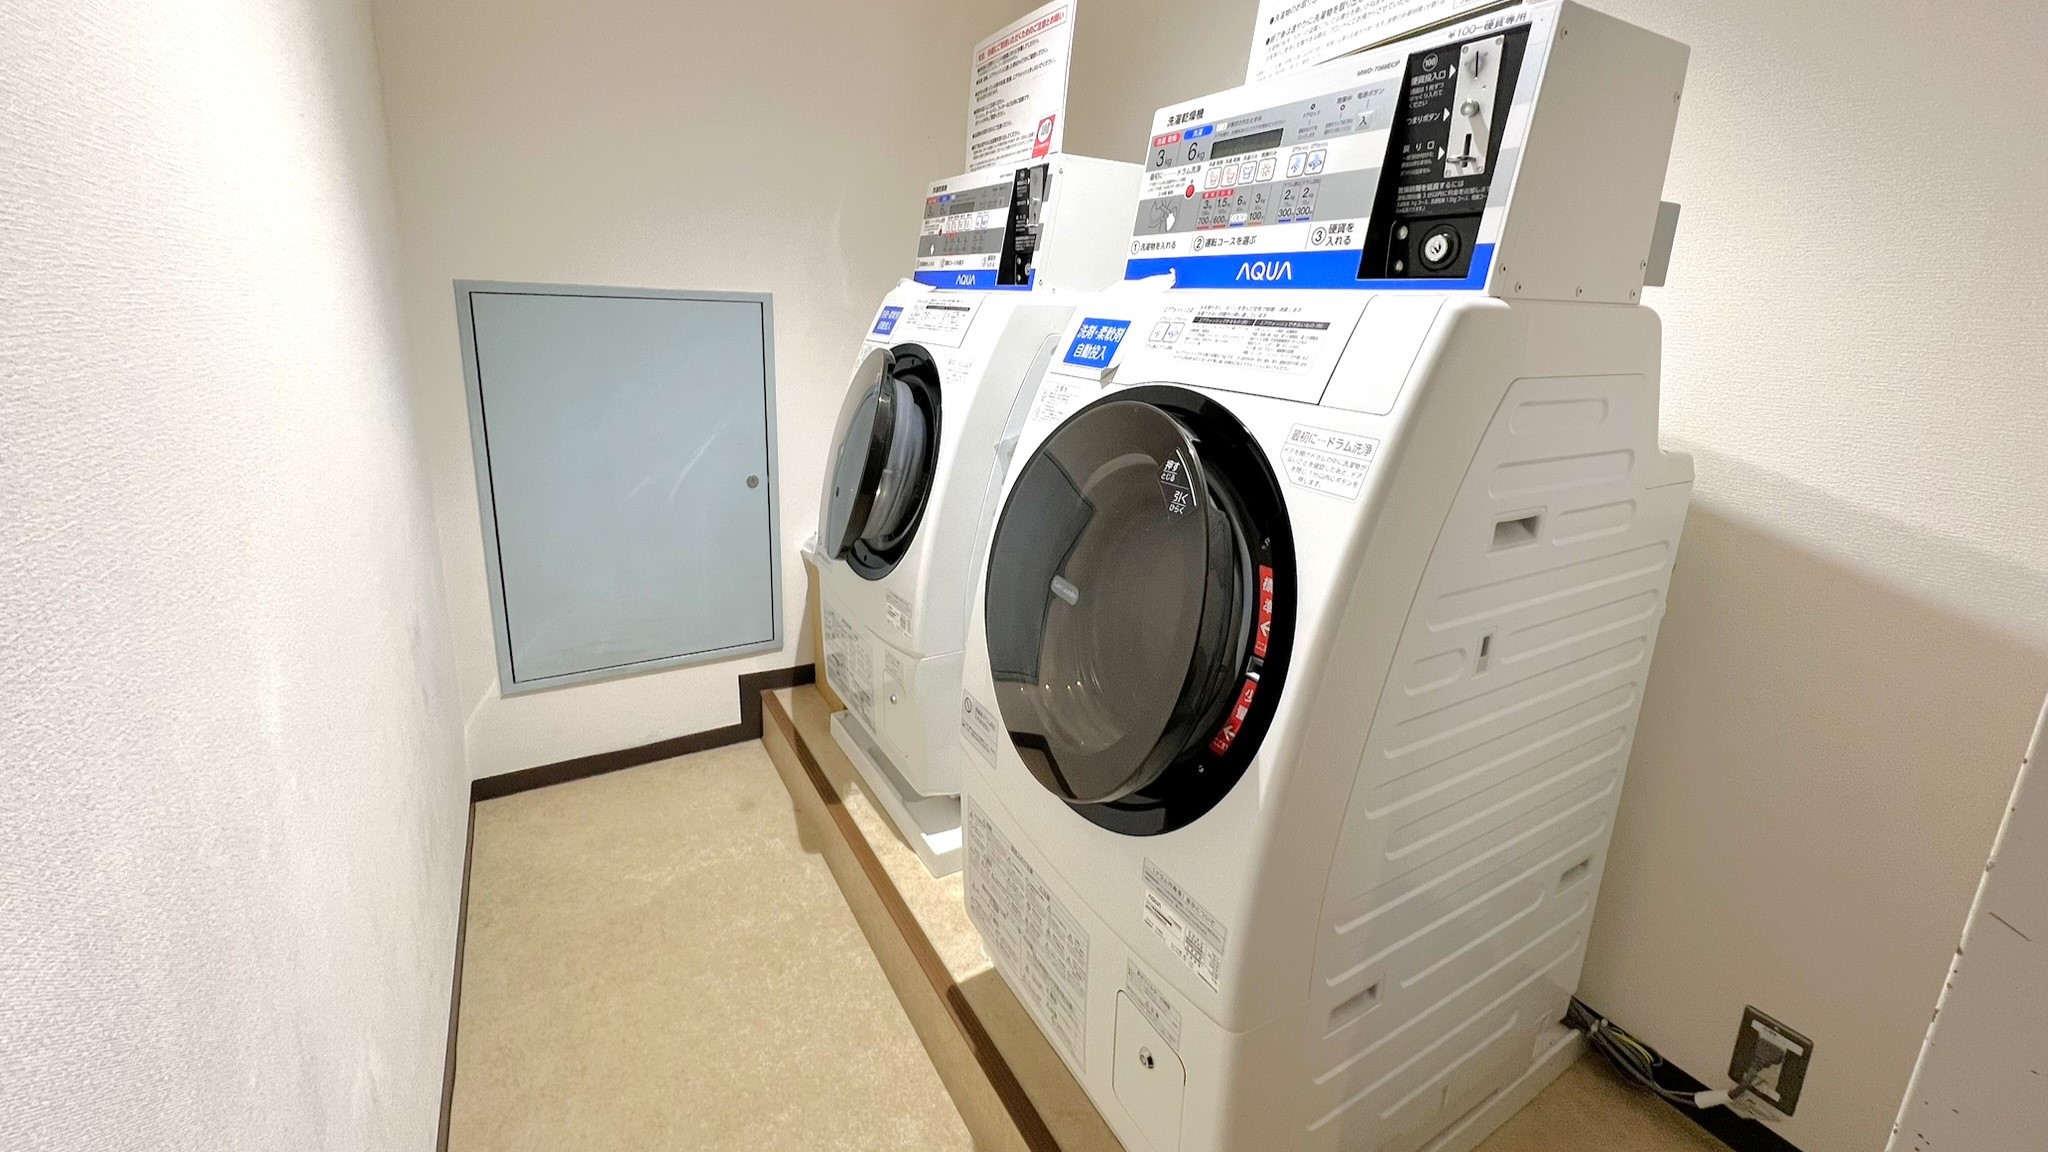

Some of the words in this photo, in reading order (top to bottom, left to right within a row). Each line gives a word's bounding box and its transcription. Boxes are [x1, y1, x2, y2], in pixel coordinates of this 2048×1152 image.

[1167, 108, 1205, 127] 洗濯乾燥機
[1328, 222, 1355, 234] 硬貨を
[1205, 235, 1257, 248] 運転コースを選ぶ
[1325, 235, 1352, 247] 入れる
[1235, 260, 1292, 281] AQUA
[955, 274, 976, 286] AQUA
[1077, 324, 1127, 343] 洗剤・柔軟剤
[1073, 342, 1108, 361] 自動投入
[1164, 459, 1180, 472] 押す
[1160, 472, 1176, 482] とじる
[1173, 490, 1189, 504] 引く
[1169, 504, 1185, 515] ひらく
